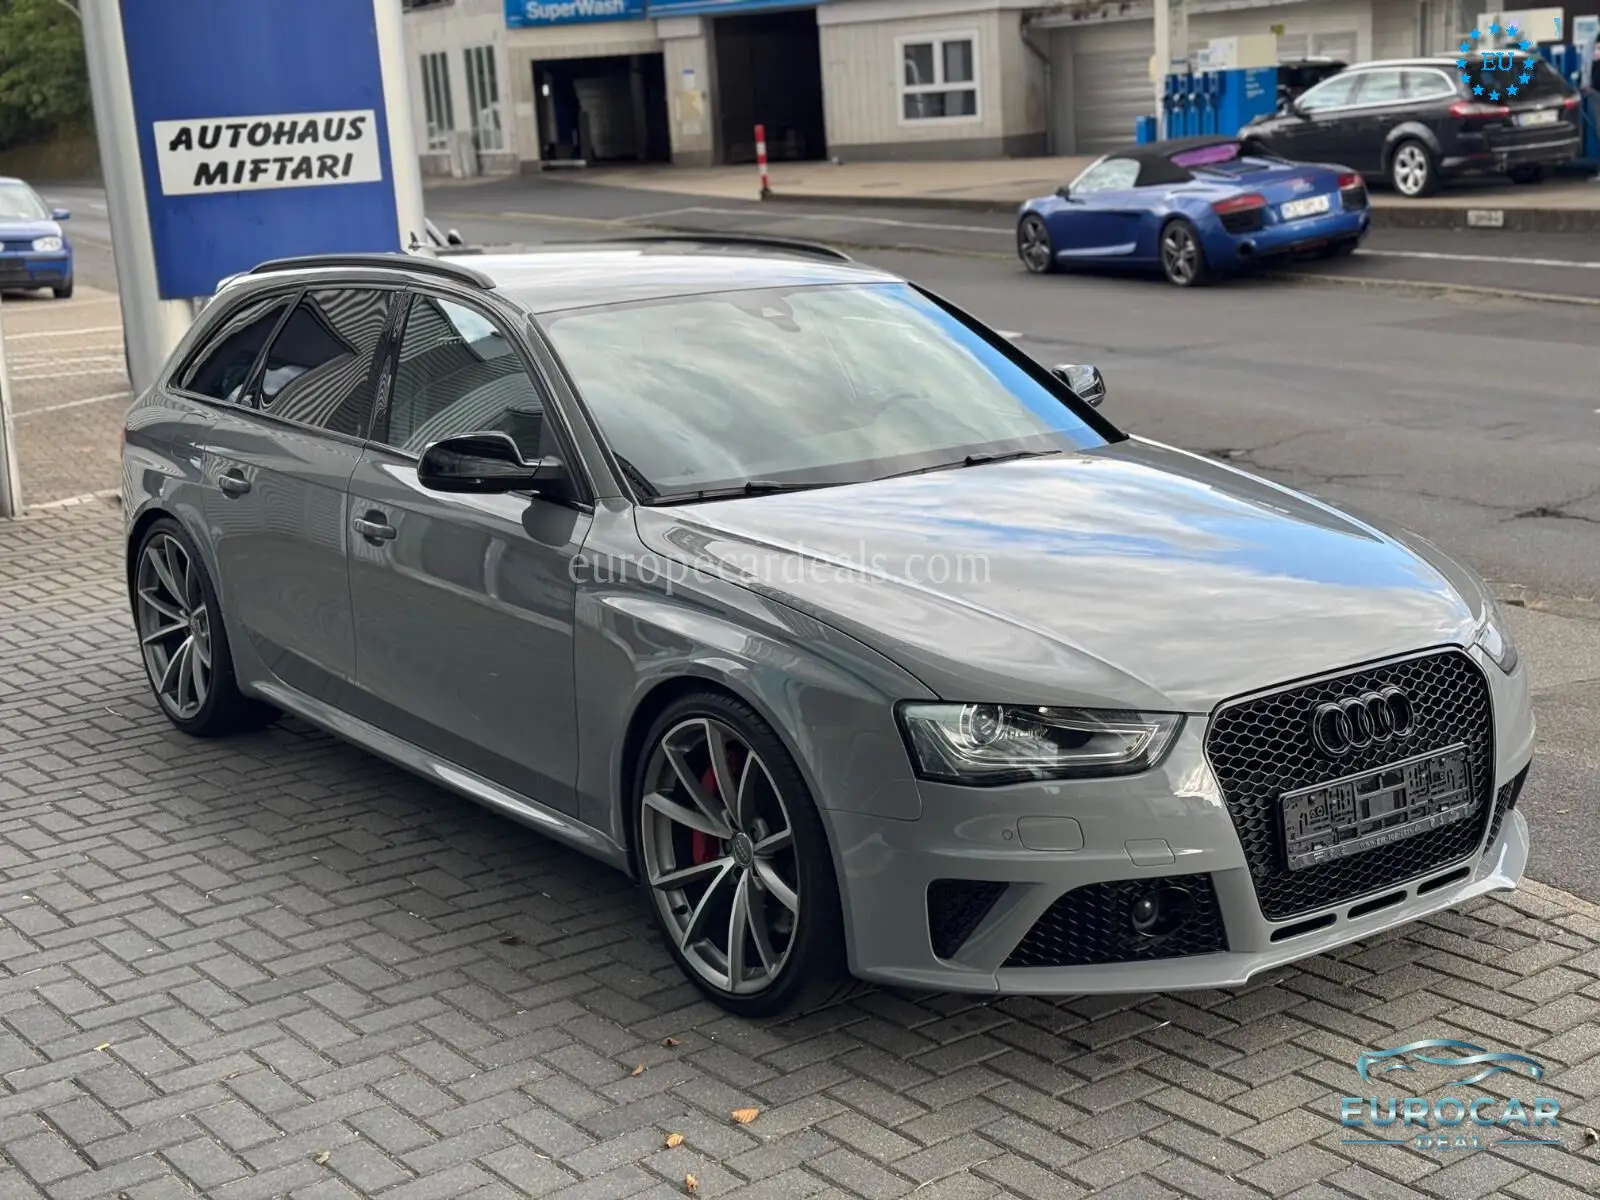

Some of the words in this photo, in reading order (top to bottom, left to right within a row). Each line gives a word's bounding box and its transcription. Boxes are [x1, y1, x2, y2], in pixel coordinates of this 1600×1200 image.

[525, 0, 624, 22] SuperWash
[169, 117, 366, 151] AUTOHAUS
[193, 153, 353, 186] MIFTARI
